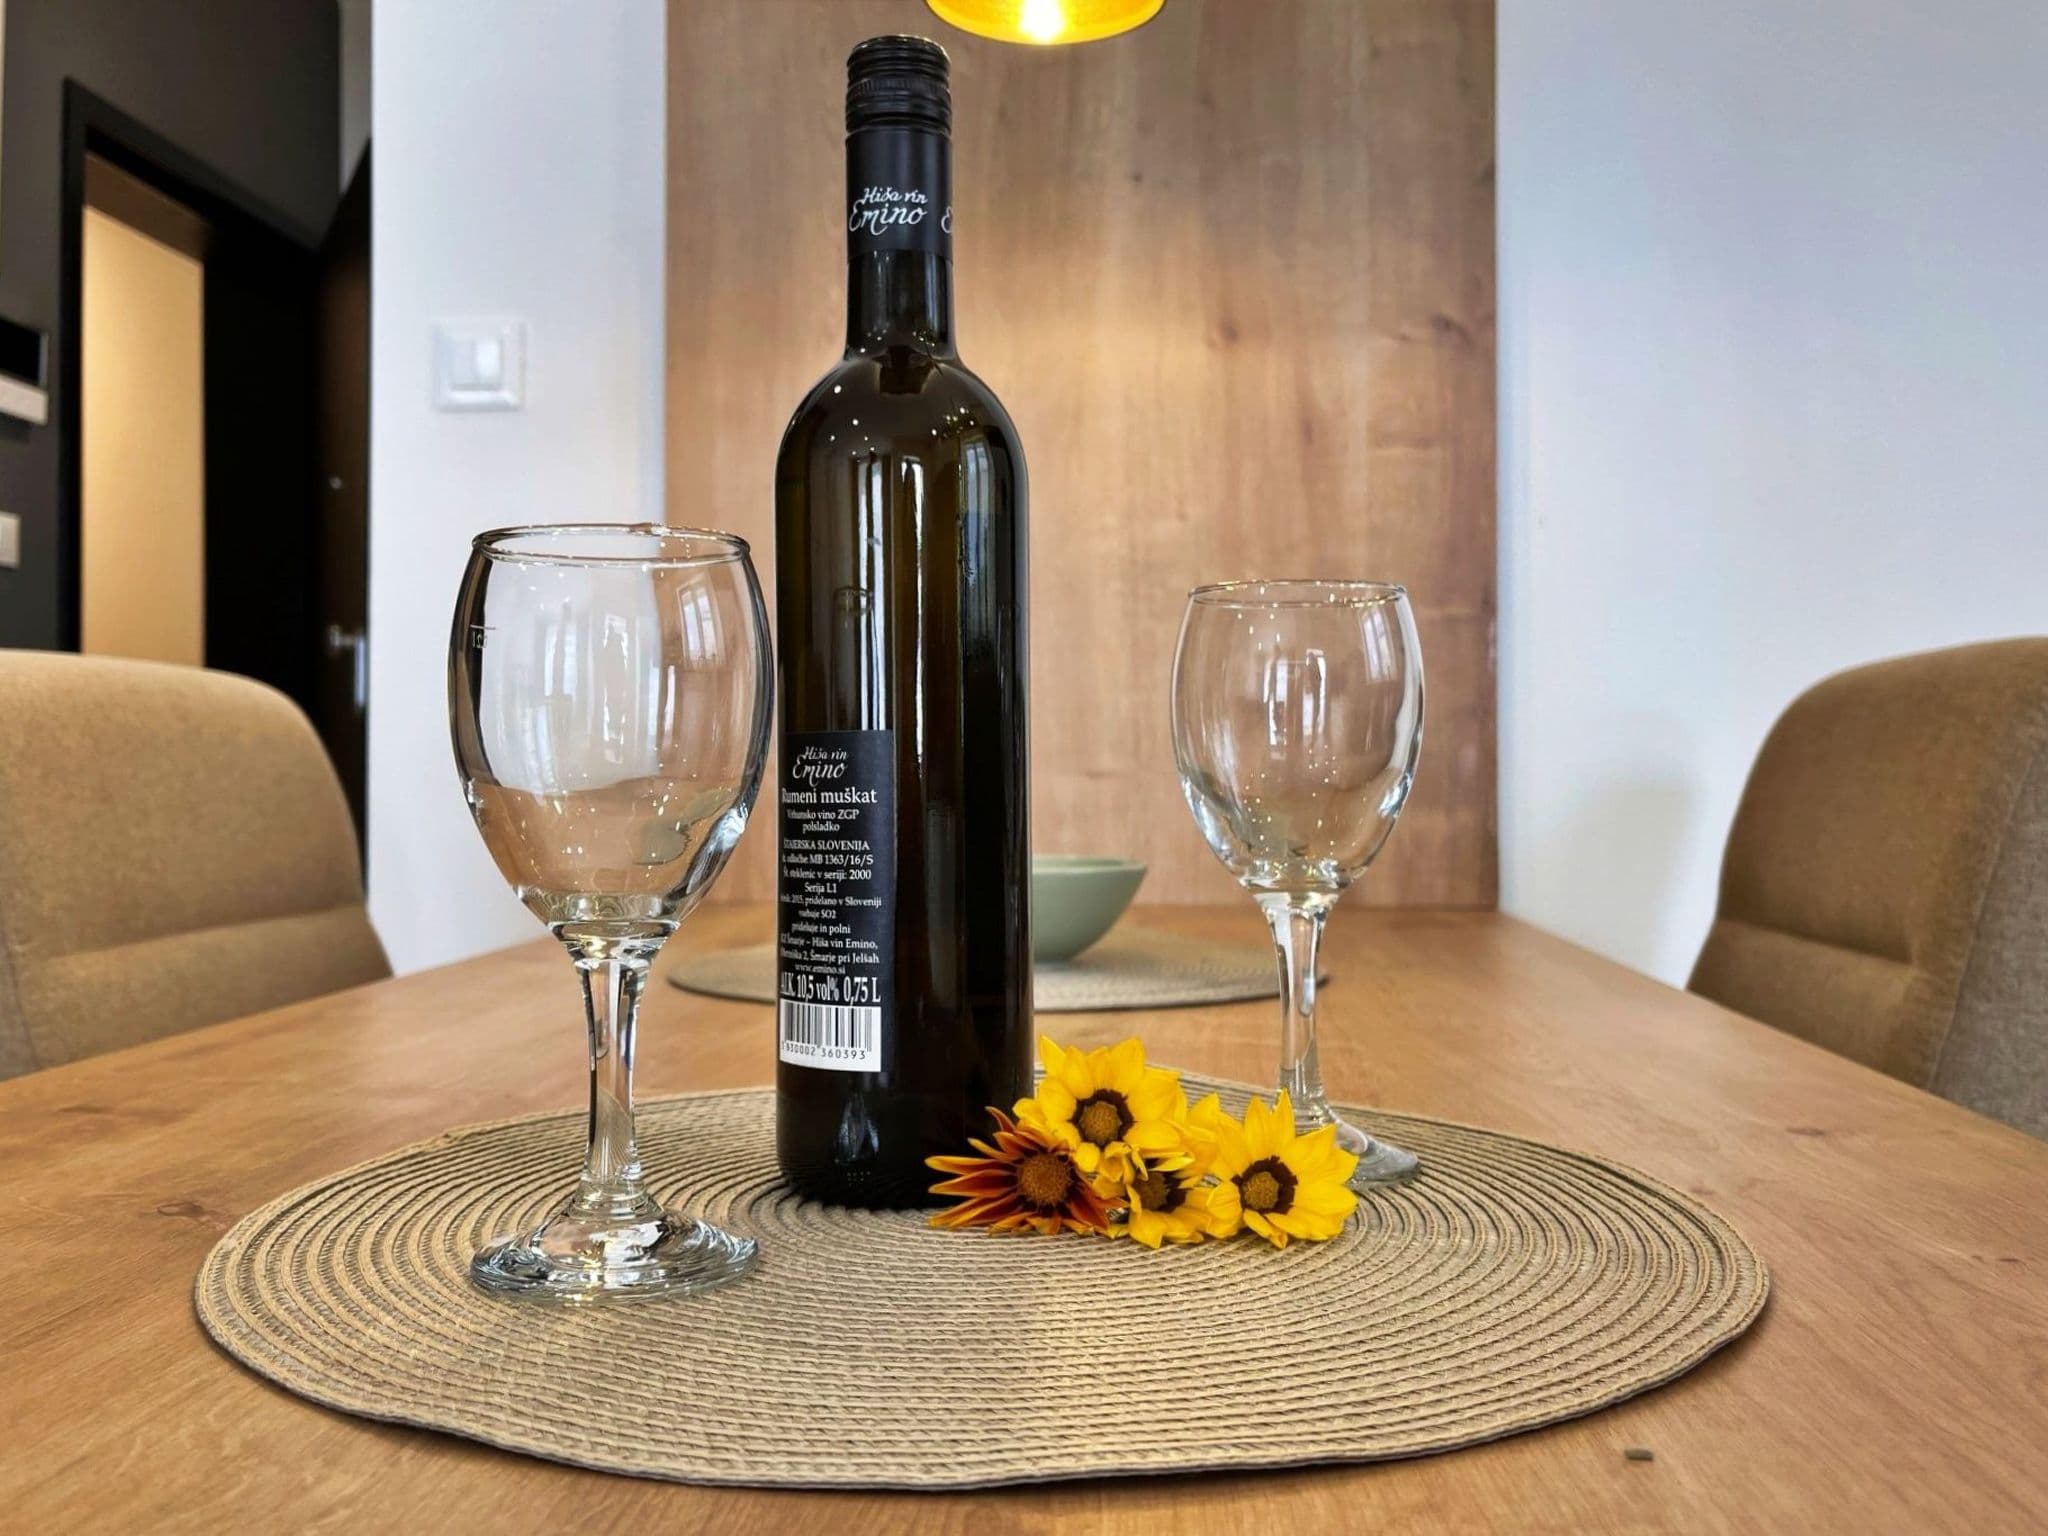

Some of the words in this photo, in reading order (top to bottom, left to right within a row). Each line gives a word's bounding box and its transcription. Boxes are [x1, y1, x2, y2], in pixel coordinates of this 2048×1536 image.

[849, 199, 927, 235] Emino
[792, 755, 847, 787] Emino
[820, 786, 878, 803] muškat
[837, 808, 859, 819] ZGP
[802, 821, 840, 833] polsladko
[817, 839, 870, 850] SLOVENIJA
[848, 869, 871, 879] 2000
[844, 896, 882, 907] Sloveniji
[828, 923, 850, 935] polni
[829, 938, 843, 948] vin
[845, 938, 877, 949] Emino,
[837, 953, 851, 964] pri
[852, 952, 880, 963] Jelšah
[843, 975, 868, 1007] 0,75
[820, 1047, 866, 1059] 360393
